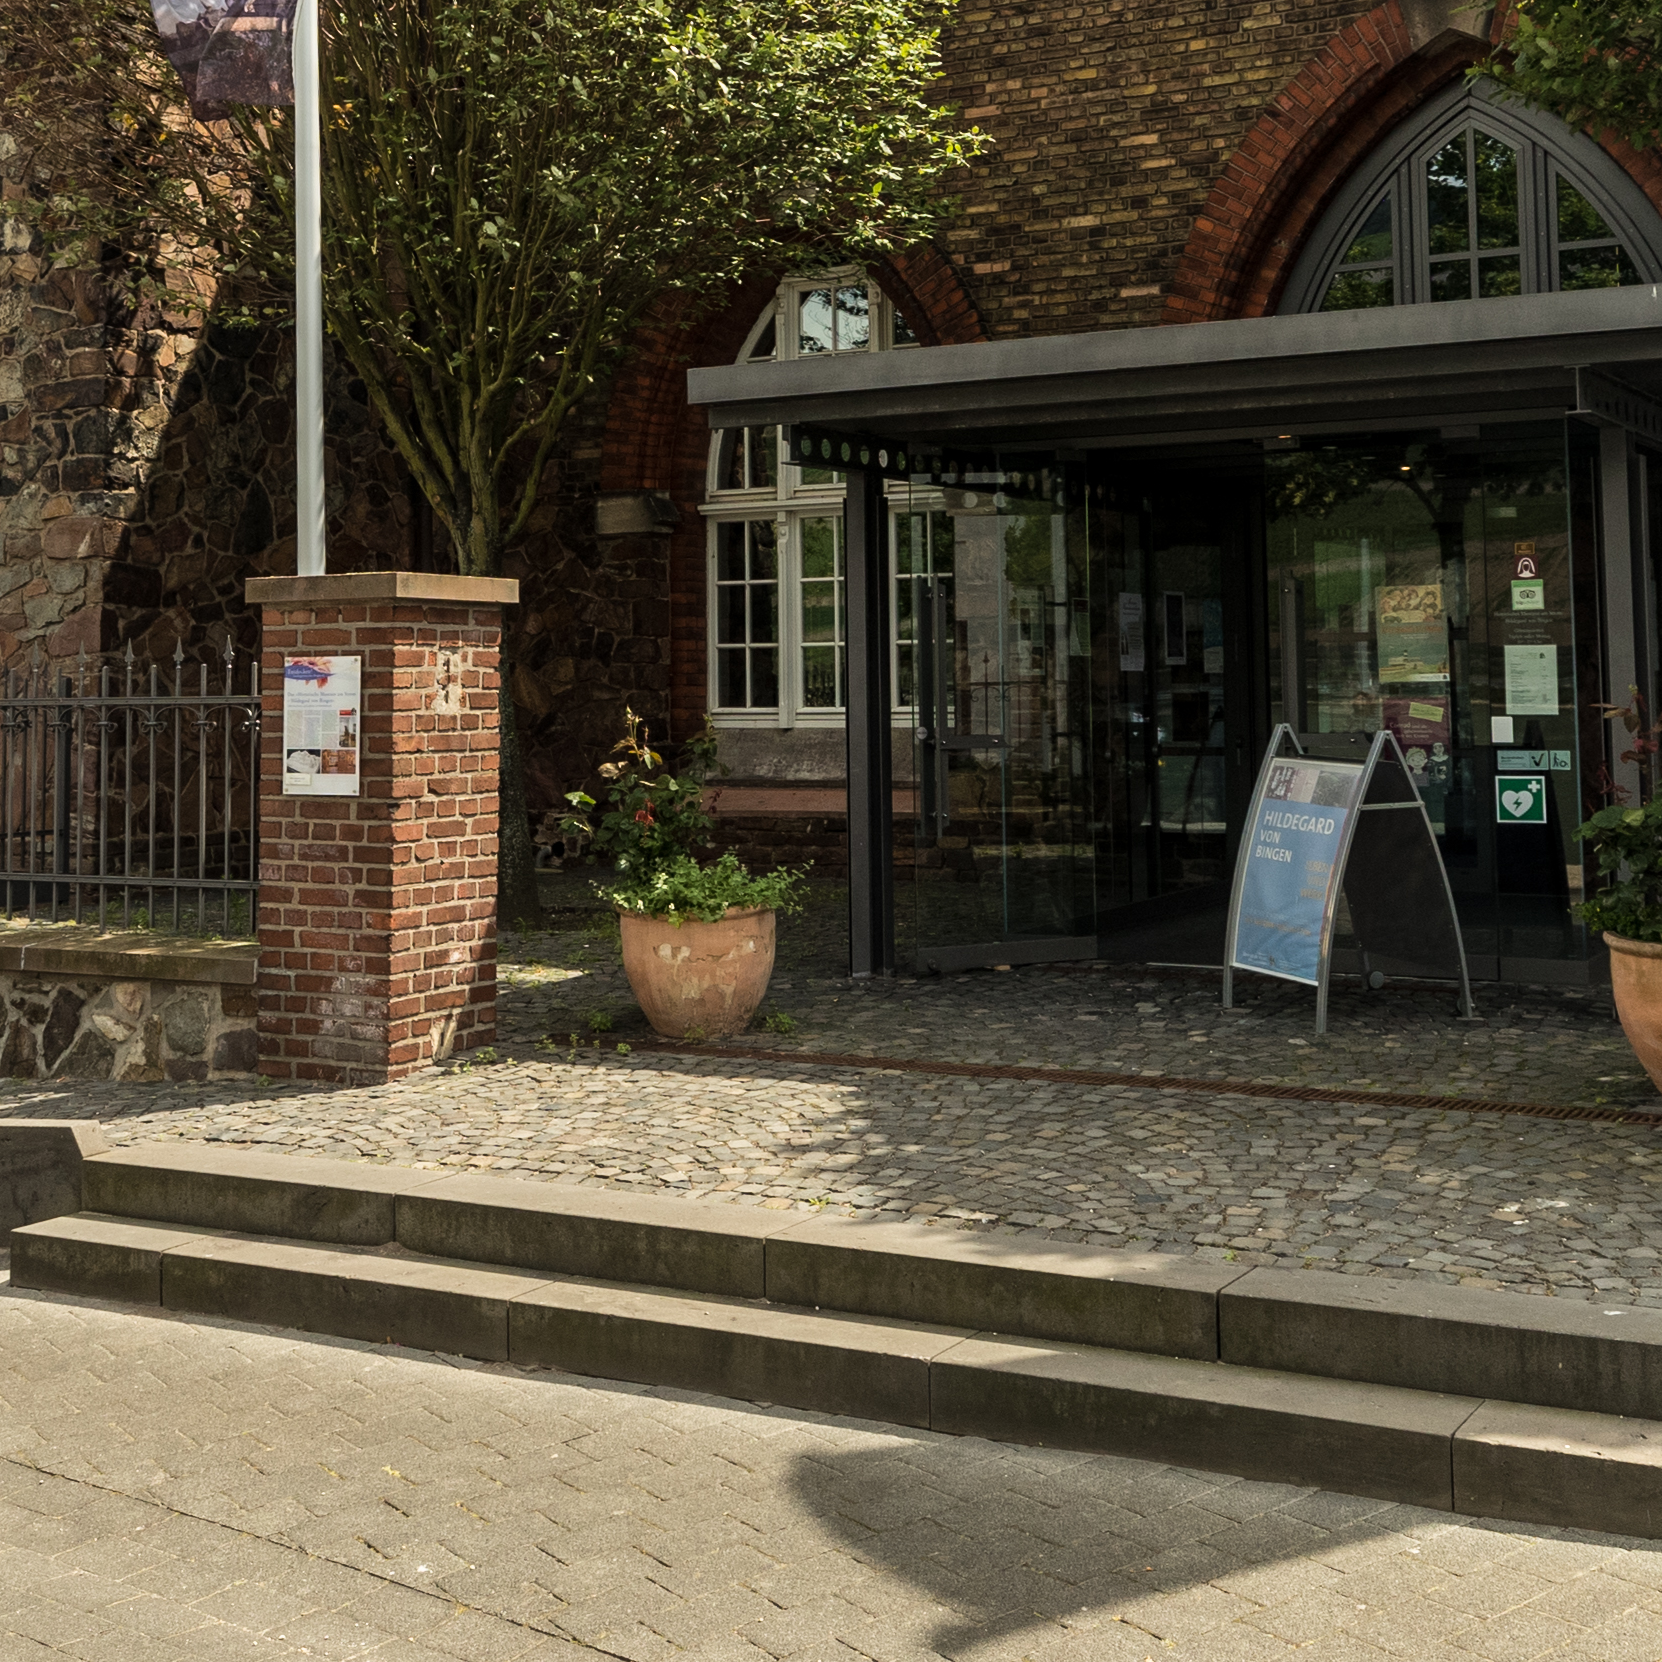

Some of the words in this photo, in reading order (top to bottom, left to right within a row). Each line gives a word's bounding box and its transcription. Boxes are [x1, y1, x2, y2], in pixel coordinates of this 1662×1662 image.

[1263, 810, 1335, 835] HILDEGARD
[1259, 829, 1282, 844] VON
[1254, 845, 1293, 863] BINGEN
